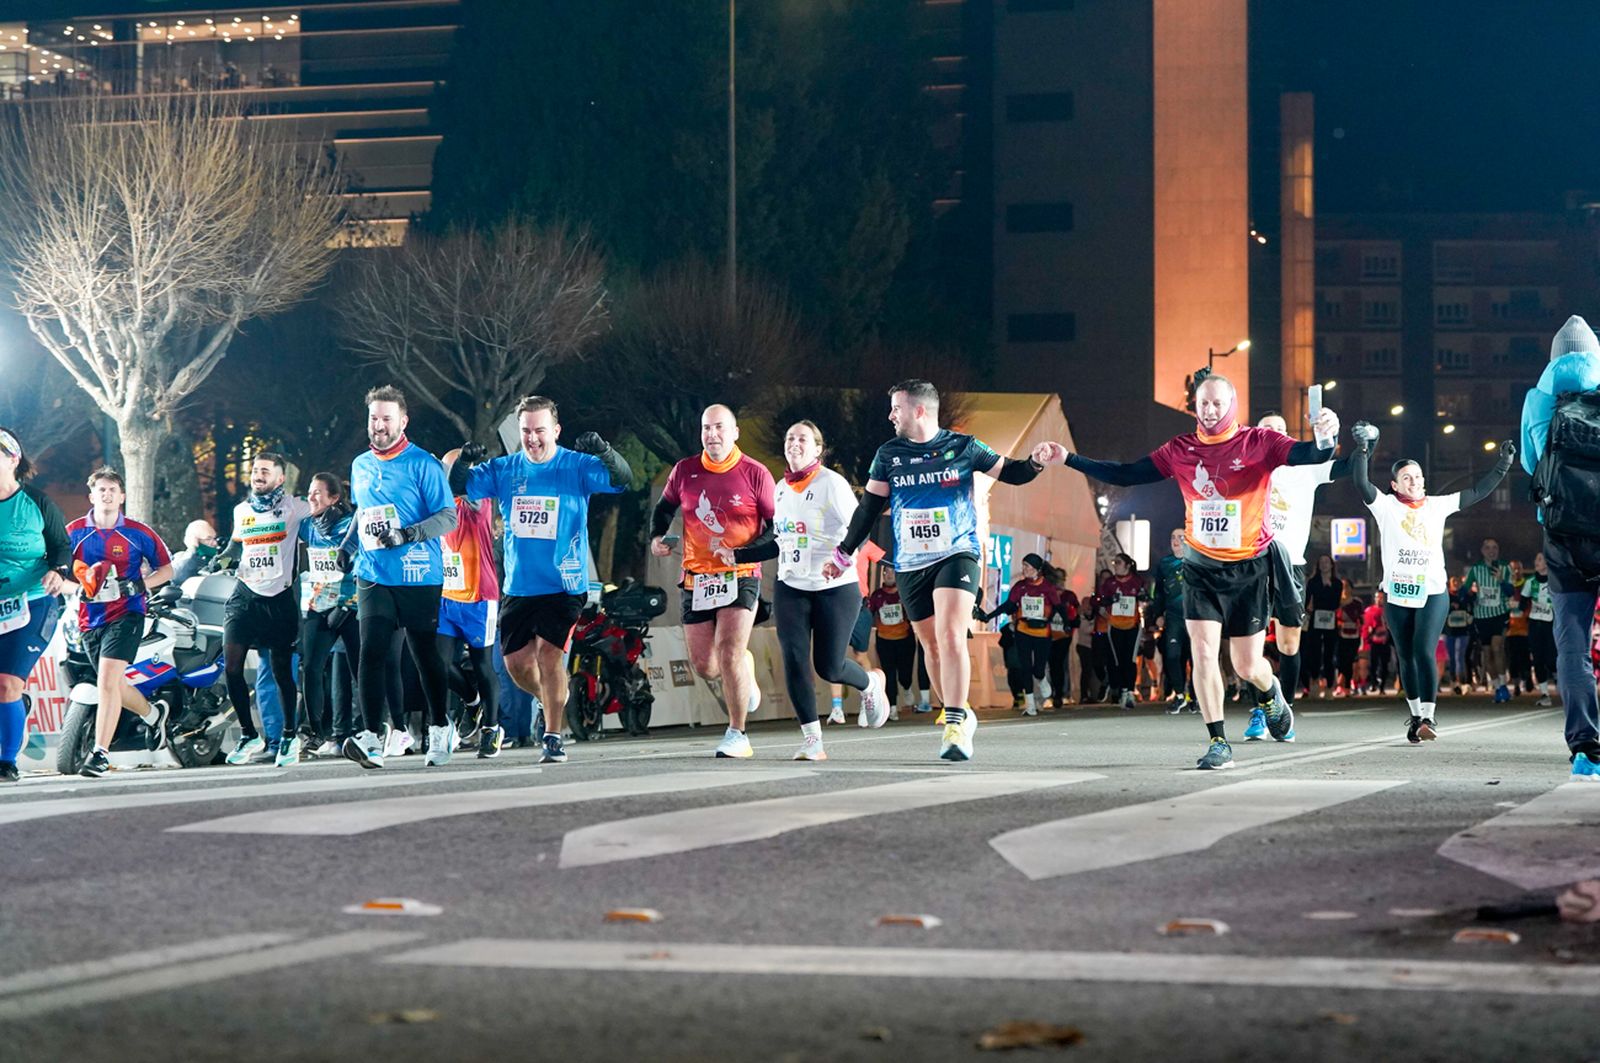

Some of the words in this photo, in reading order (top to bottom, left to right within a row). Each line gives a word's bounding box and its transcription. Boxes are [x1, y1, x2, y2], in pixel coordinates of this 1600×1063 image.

[893, 474, 915, 488] SAN
[918, 467, 959, 485] ANTÓN
[1201, 483, 1214, 497] 43
[519, 511, 549, 525] 5729
[1200, 517, 1229, 532] 7612
[364, 520, 392, 537] 4651
[909, 524, 941, 539] 1459
[1398, 548, 1419, 557] SAN
[249, 556, 275, 569] 6244
[314, 560, 336, 571] 6243
[442, 566, 458, 577] 393
[703, 583, 729, 598] 7614
[1393, 582, 1421, 595] 9597
